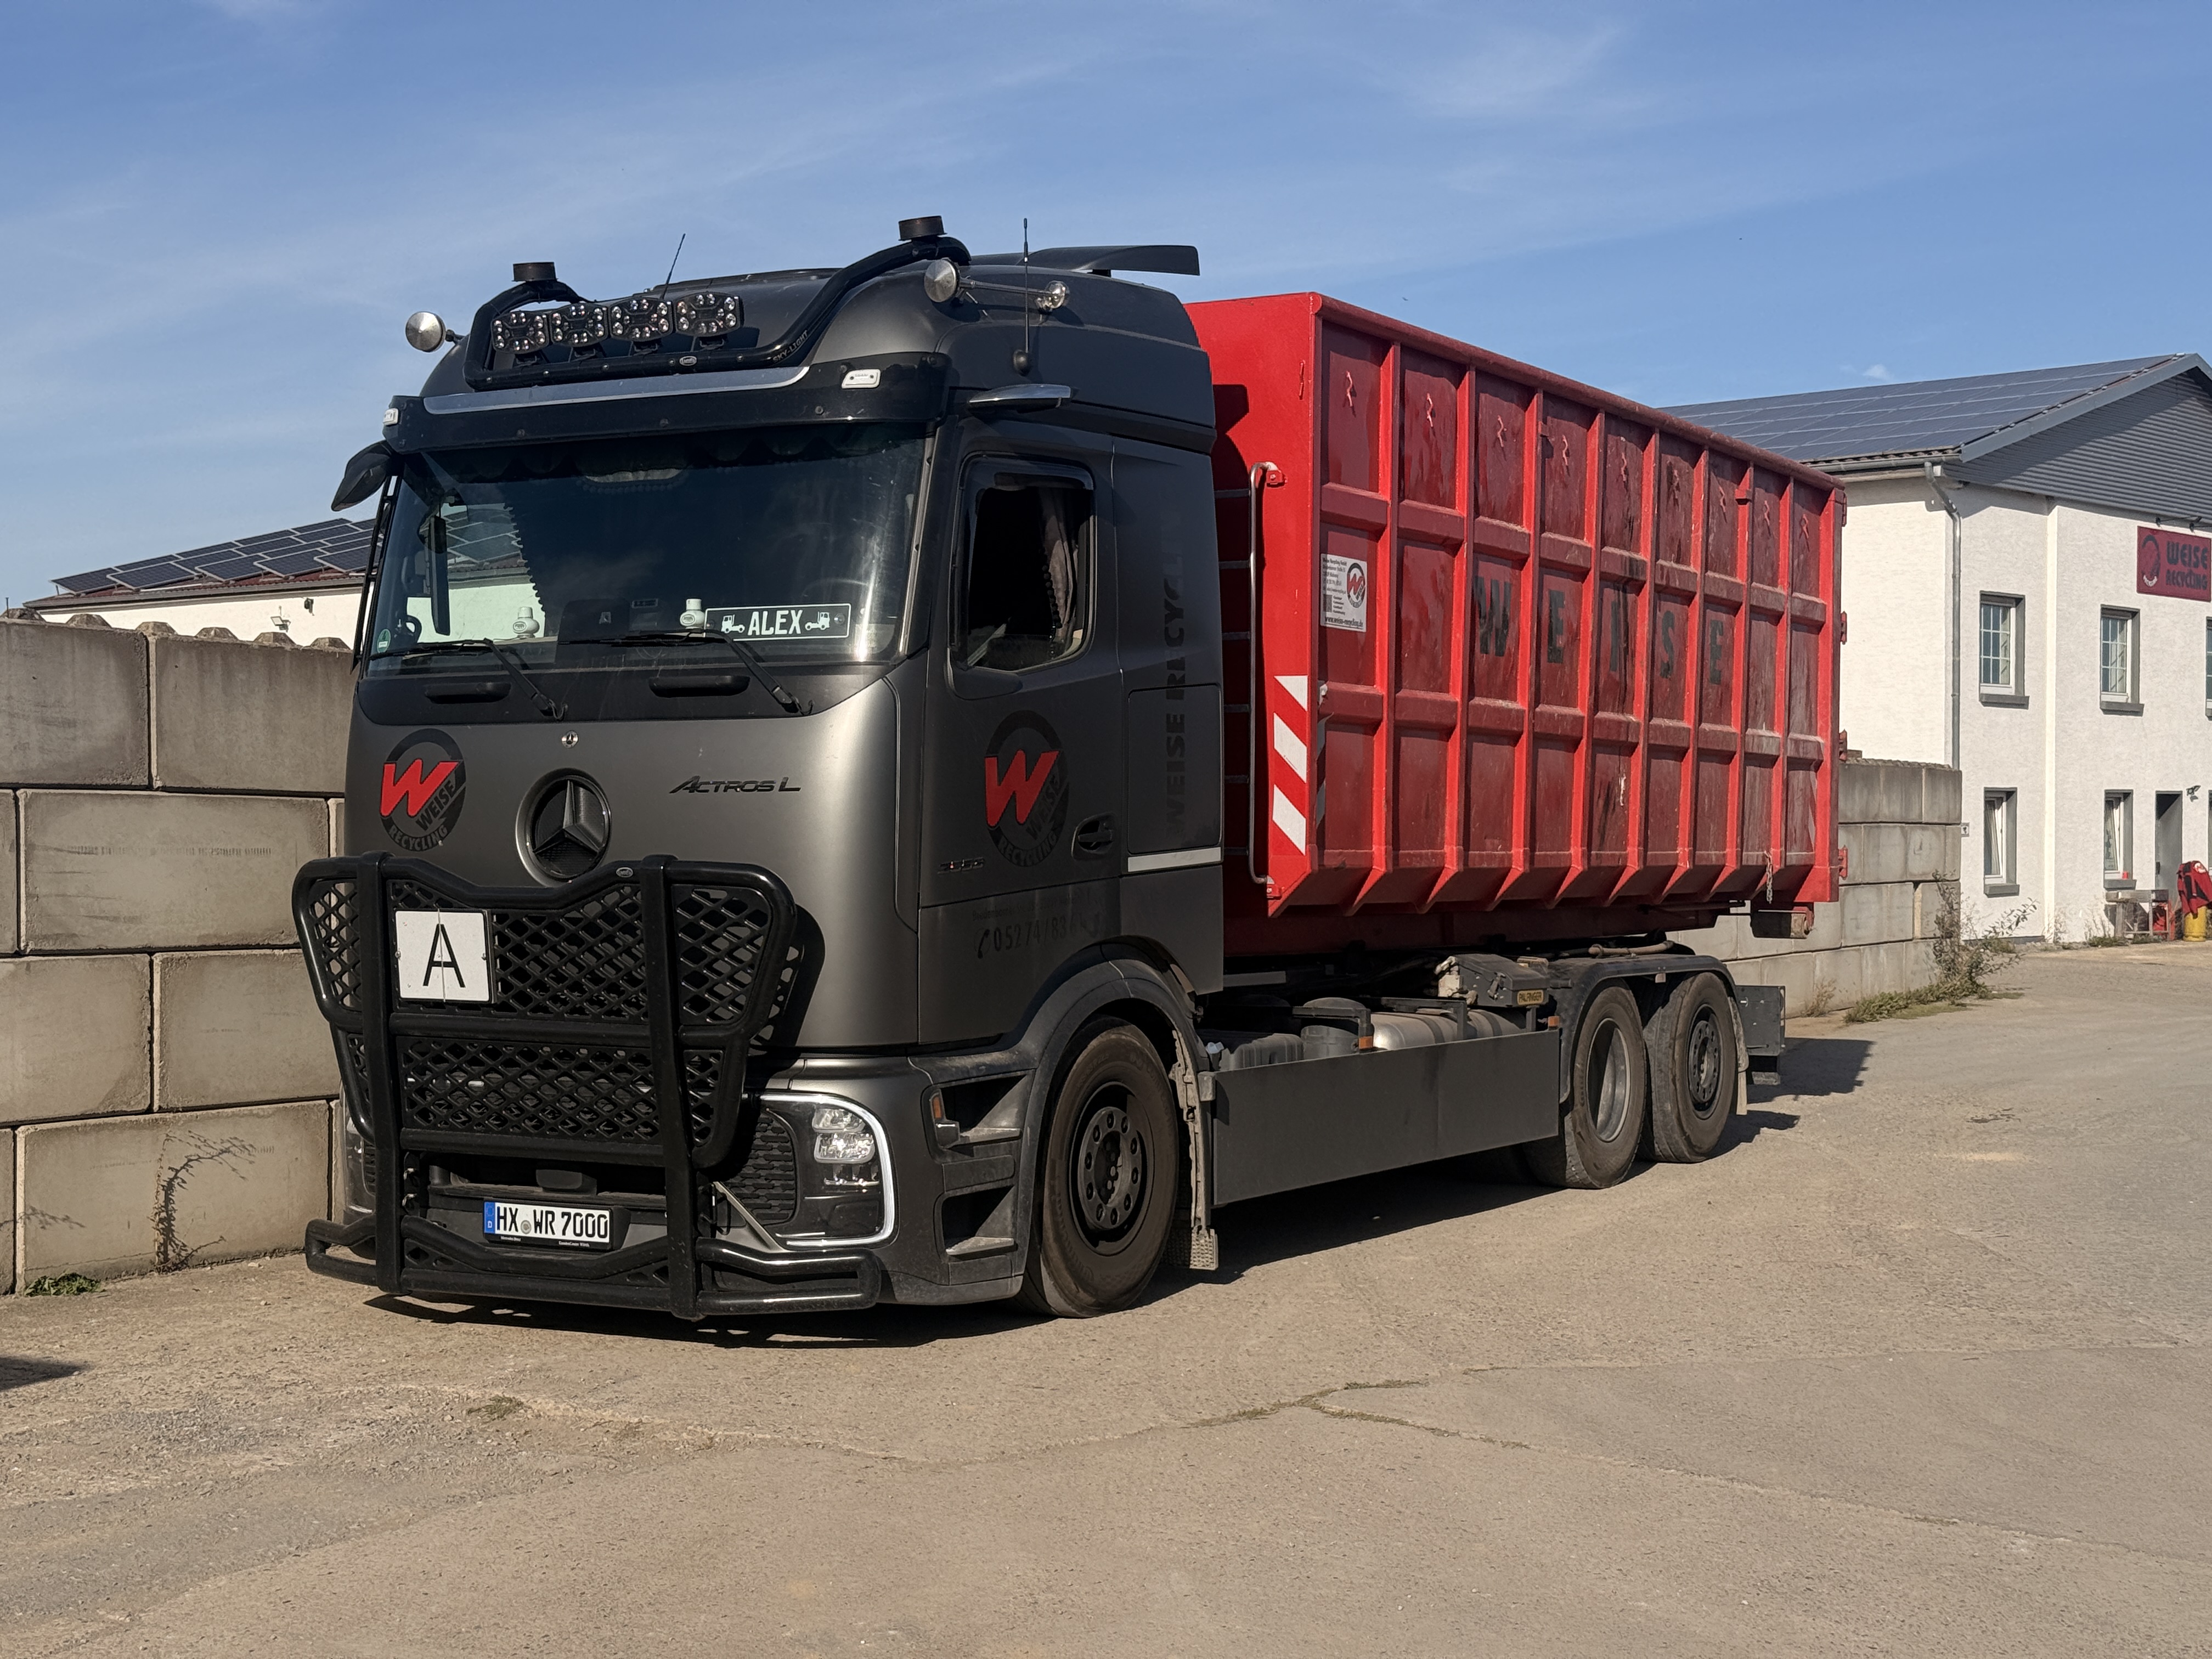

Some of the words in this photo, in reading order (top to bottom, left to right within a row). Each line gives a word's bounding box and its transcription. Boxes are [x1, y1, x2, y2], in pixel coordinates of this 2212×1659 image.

[773, 330, 808, 363] SKY-LIGHT
[2166, 540, 2208, 570] WEISE
[2165, 569, 2208, 590] RECYCLING
[748, 609, 804, 636] ALEX
[1474, 576, 1724, 685] WEISE
[380, 758, 460, 817] W
[669, 775, 775, 794] ACTROS
[778, 777, 802, 792] L
[985, 749, 1060, 827] W
[1166, 713, 1186, 837] WEISE
[415, 780, 455, 832] WEISE
[1025, 773, 1060, 841] WEISE
[388, 825, 448, 850] RECYCLING
[998, 832, 1058, 866] RECYCLING
[422, 923, 466, 988] A
[496, 1206, 519, 1232] HX
[533, 1209, 556, 1235] WR
[561, 1211, 608, 1239] 7000
